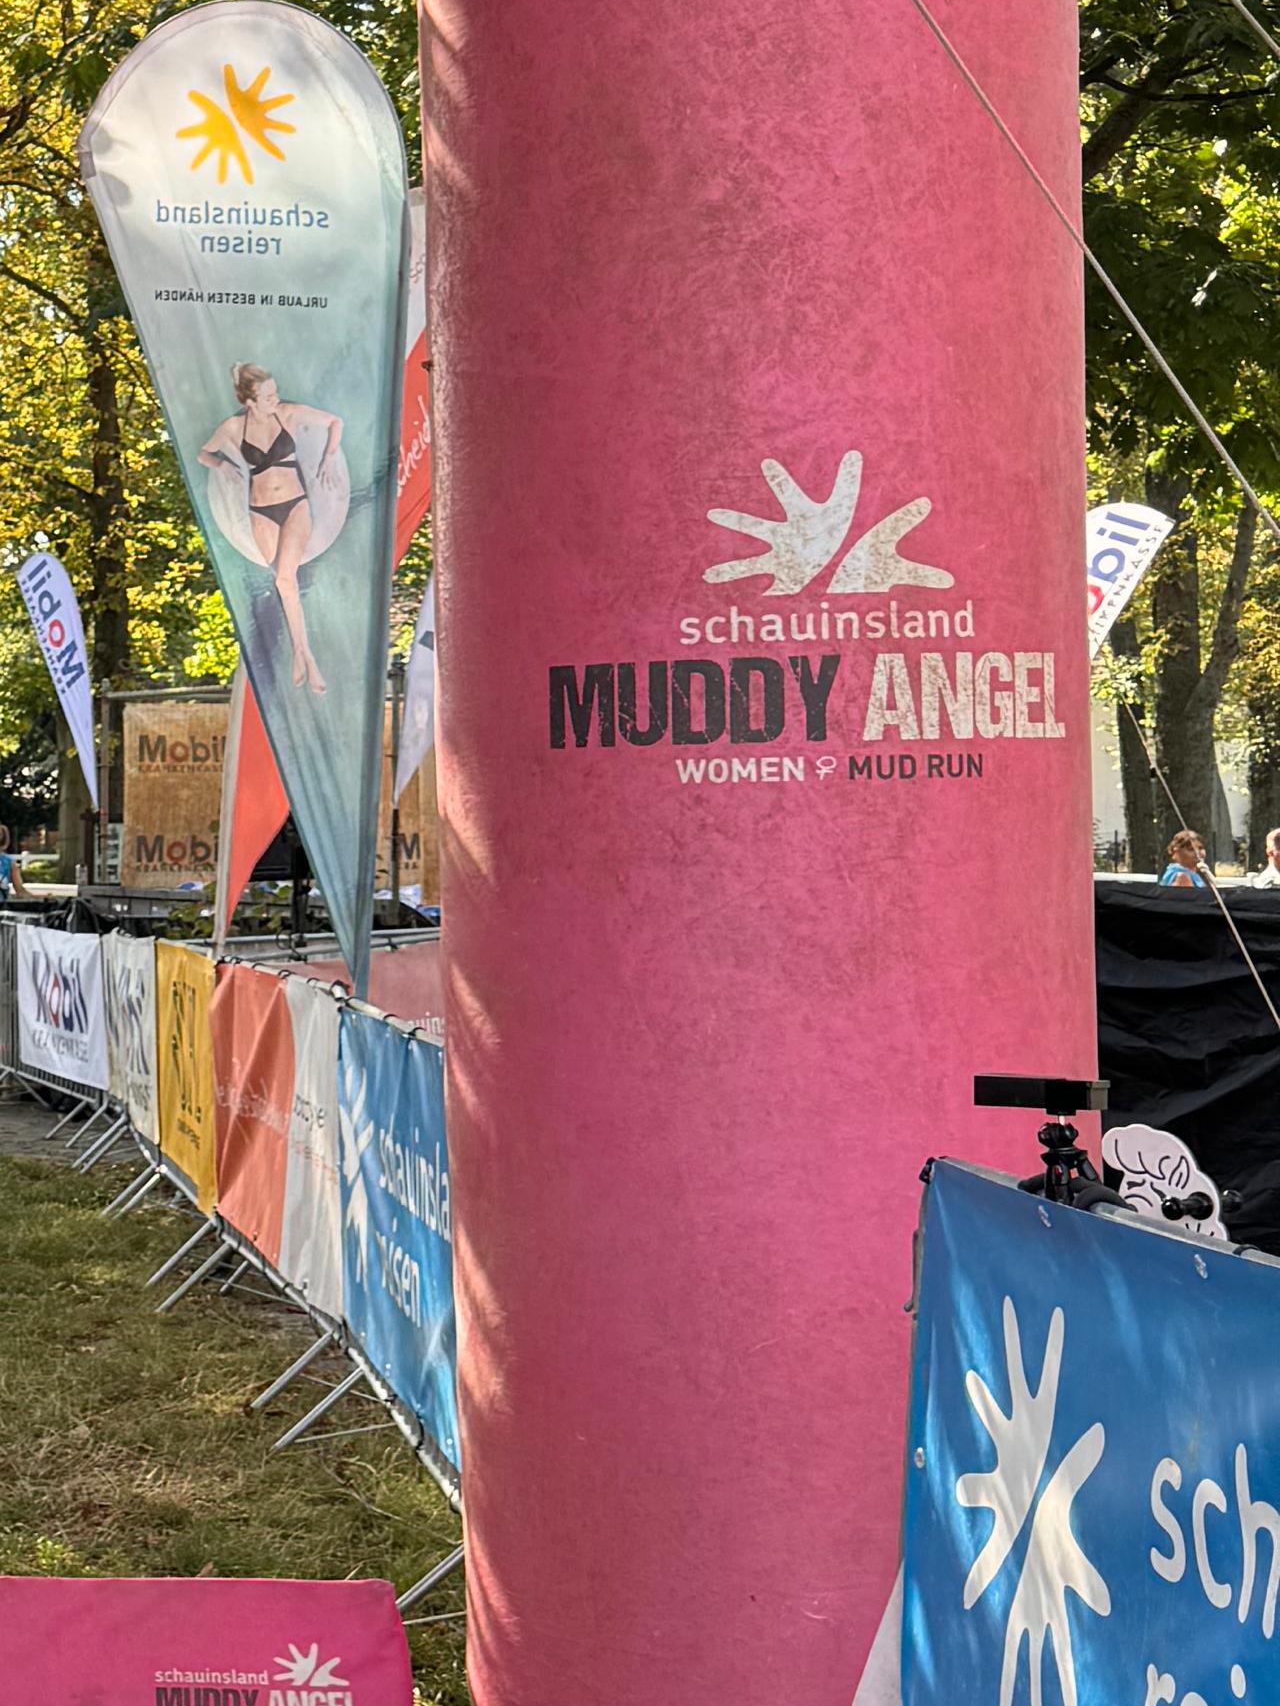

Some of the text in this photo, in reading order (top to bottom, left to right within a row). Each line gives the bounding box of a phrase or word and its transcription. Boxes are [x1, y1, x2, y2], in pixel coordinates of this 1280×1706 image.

[680, 600, 975, 646] schauinsland
[548, 652, 1066, 749] MUDDY ANGEL
[676, 753, 983, 783] WOMEN MUD RUN
[136, 835, 218, 862] Mobi
[155, 1668, 269, 1685] schauinsland
